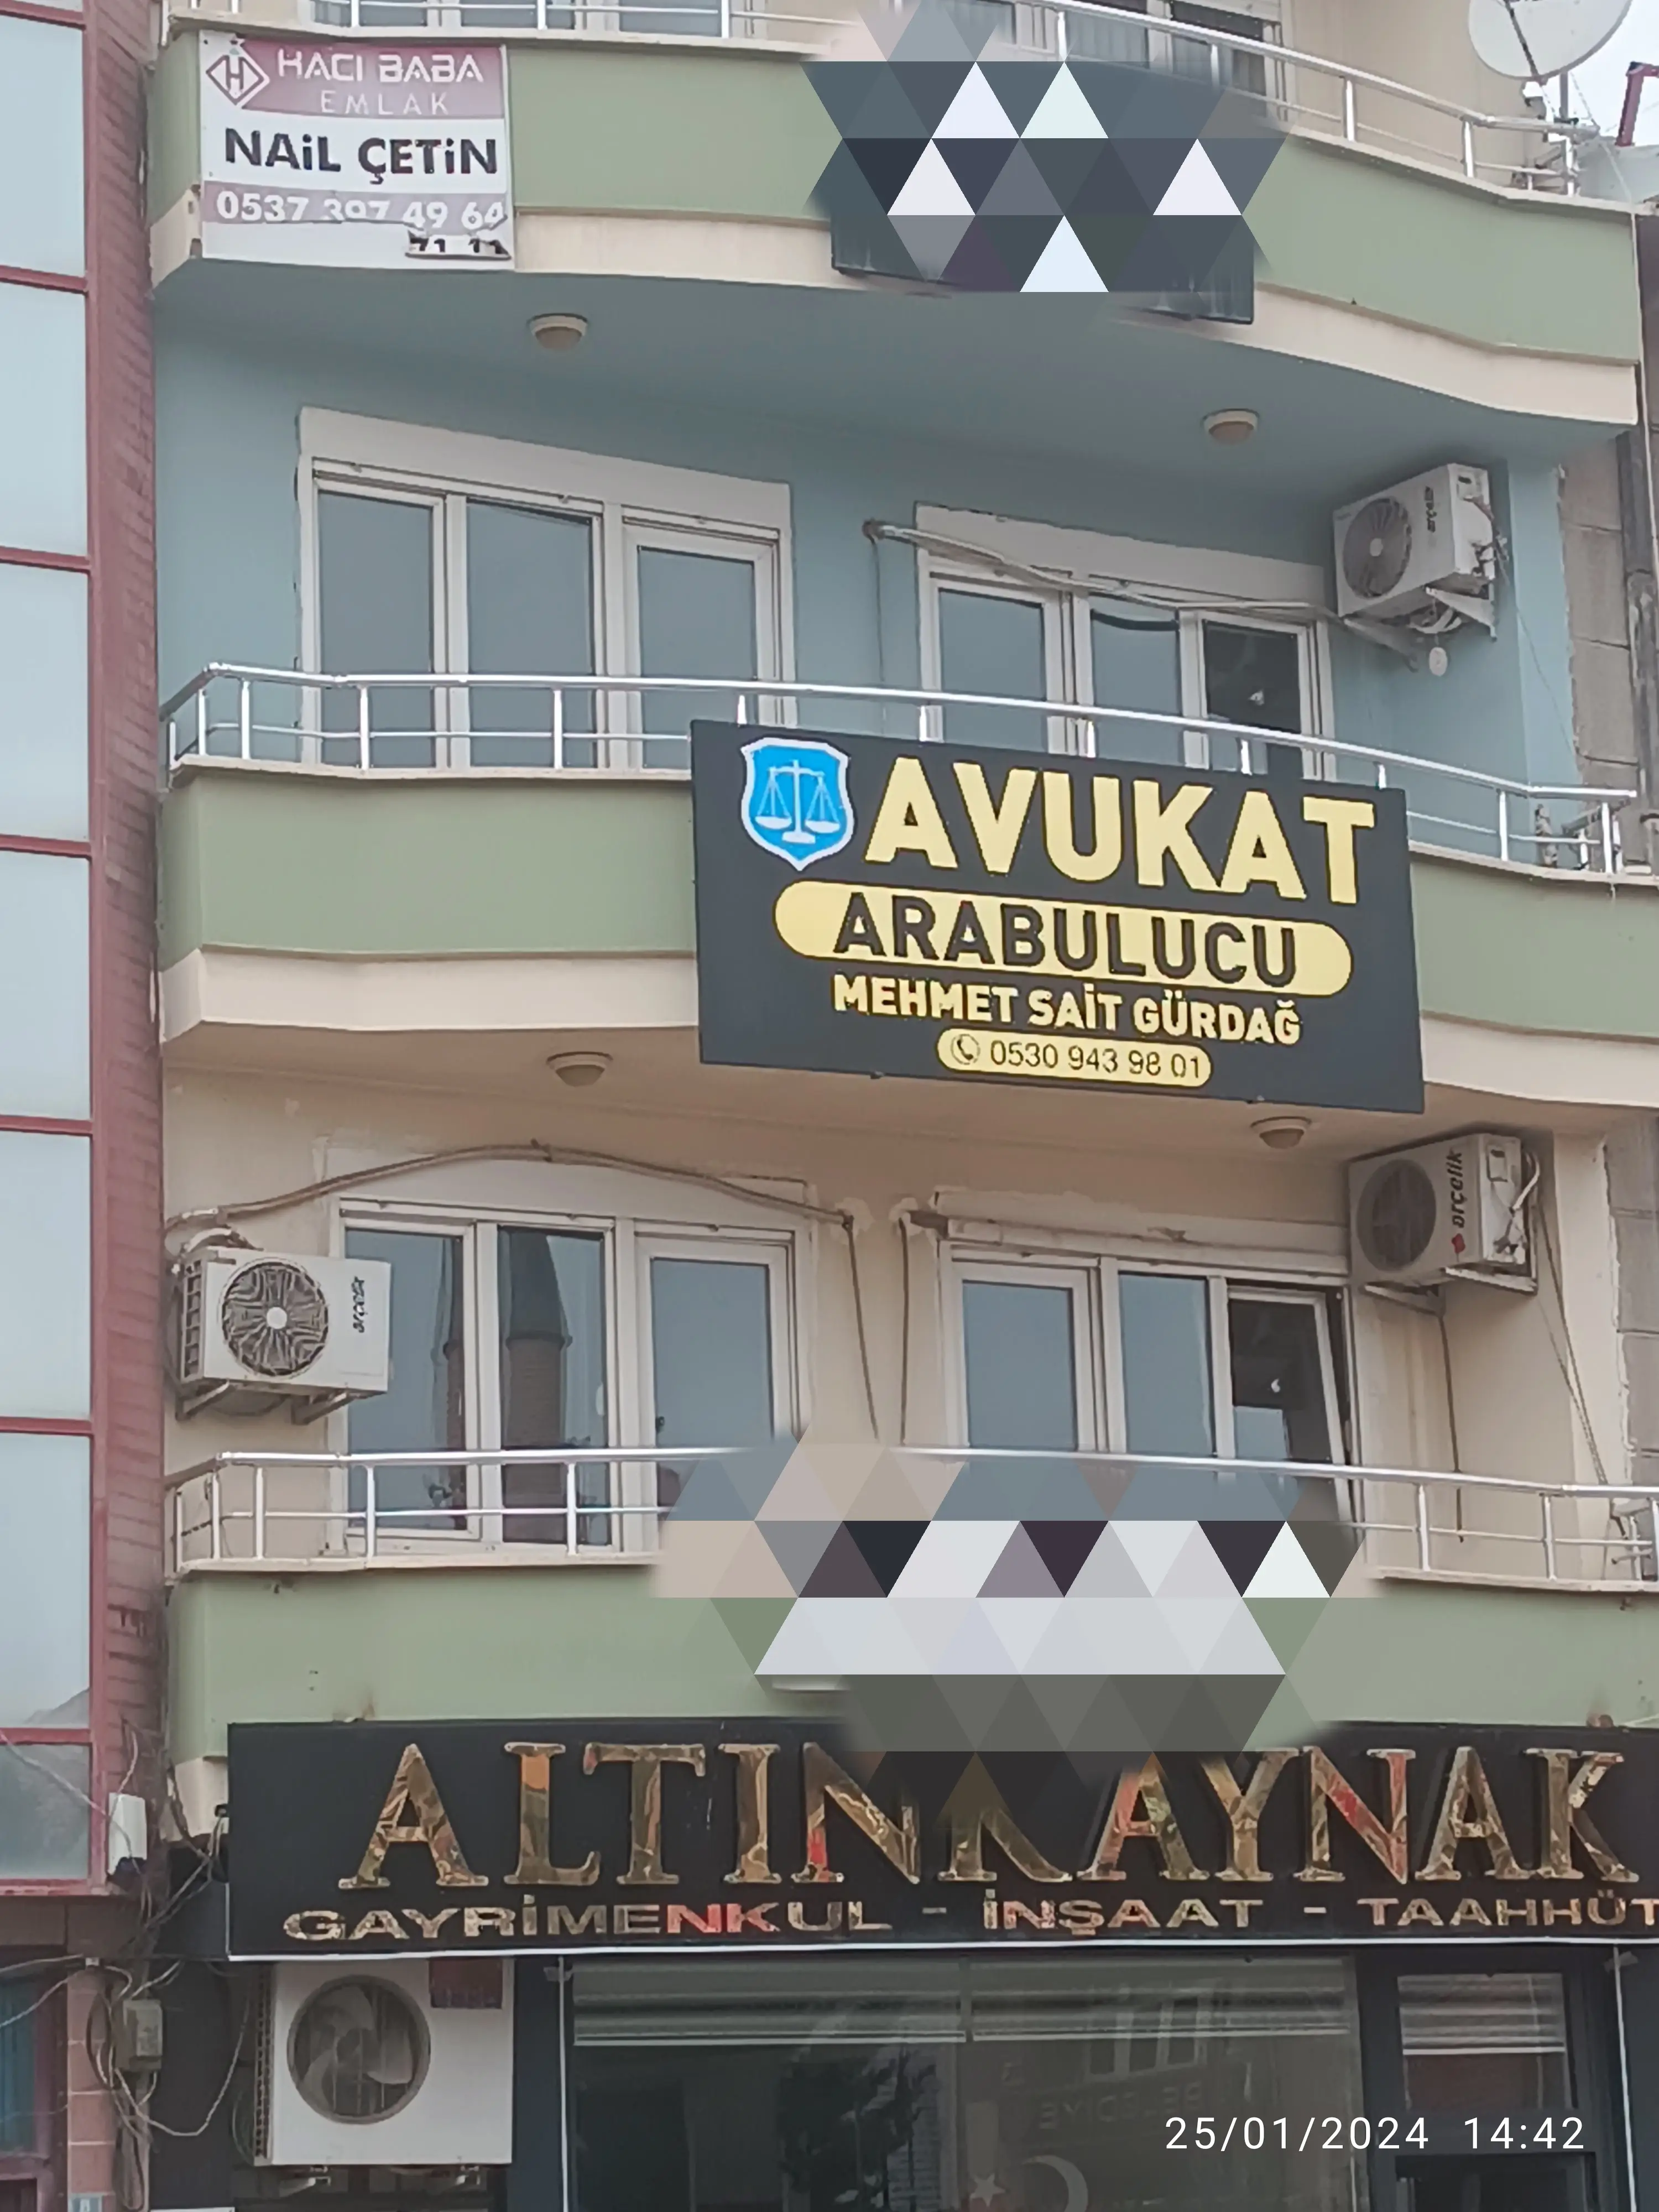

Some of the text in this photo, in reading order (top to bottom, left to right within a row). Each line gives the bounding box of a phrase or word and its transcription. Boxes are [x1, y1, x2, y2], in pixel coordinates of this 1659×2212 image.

[278, 49, 483, 82] HACI BABA
[321, 90, 448, 115] EMLAK
[217, 191, 309, 221] 0537
[864, 756, 1375, 905] AVUKAT
[833, 892, 1297, 988] ARABULUCU
[833, 974, 1302, 1045] MEHMET SAİT GÜRDAĞ
[990, 1040, 1199, 1078] 0530 943 98 01
[283, 1893, 893, 1940] GAYRİMENKUL
[983, 1888, 1263, 1936] İNŞAAT
